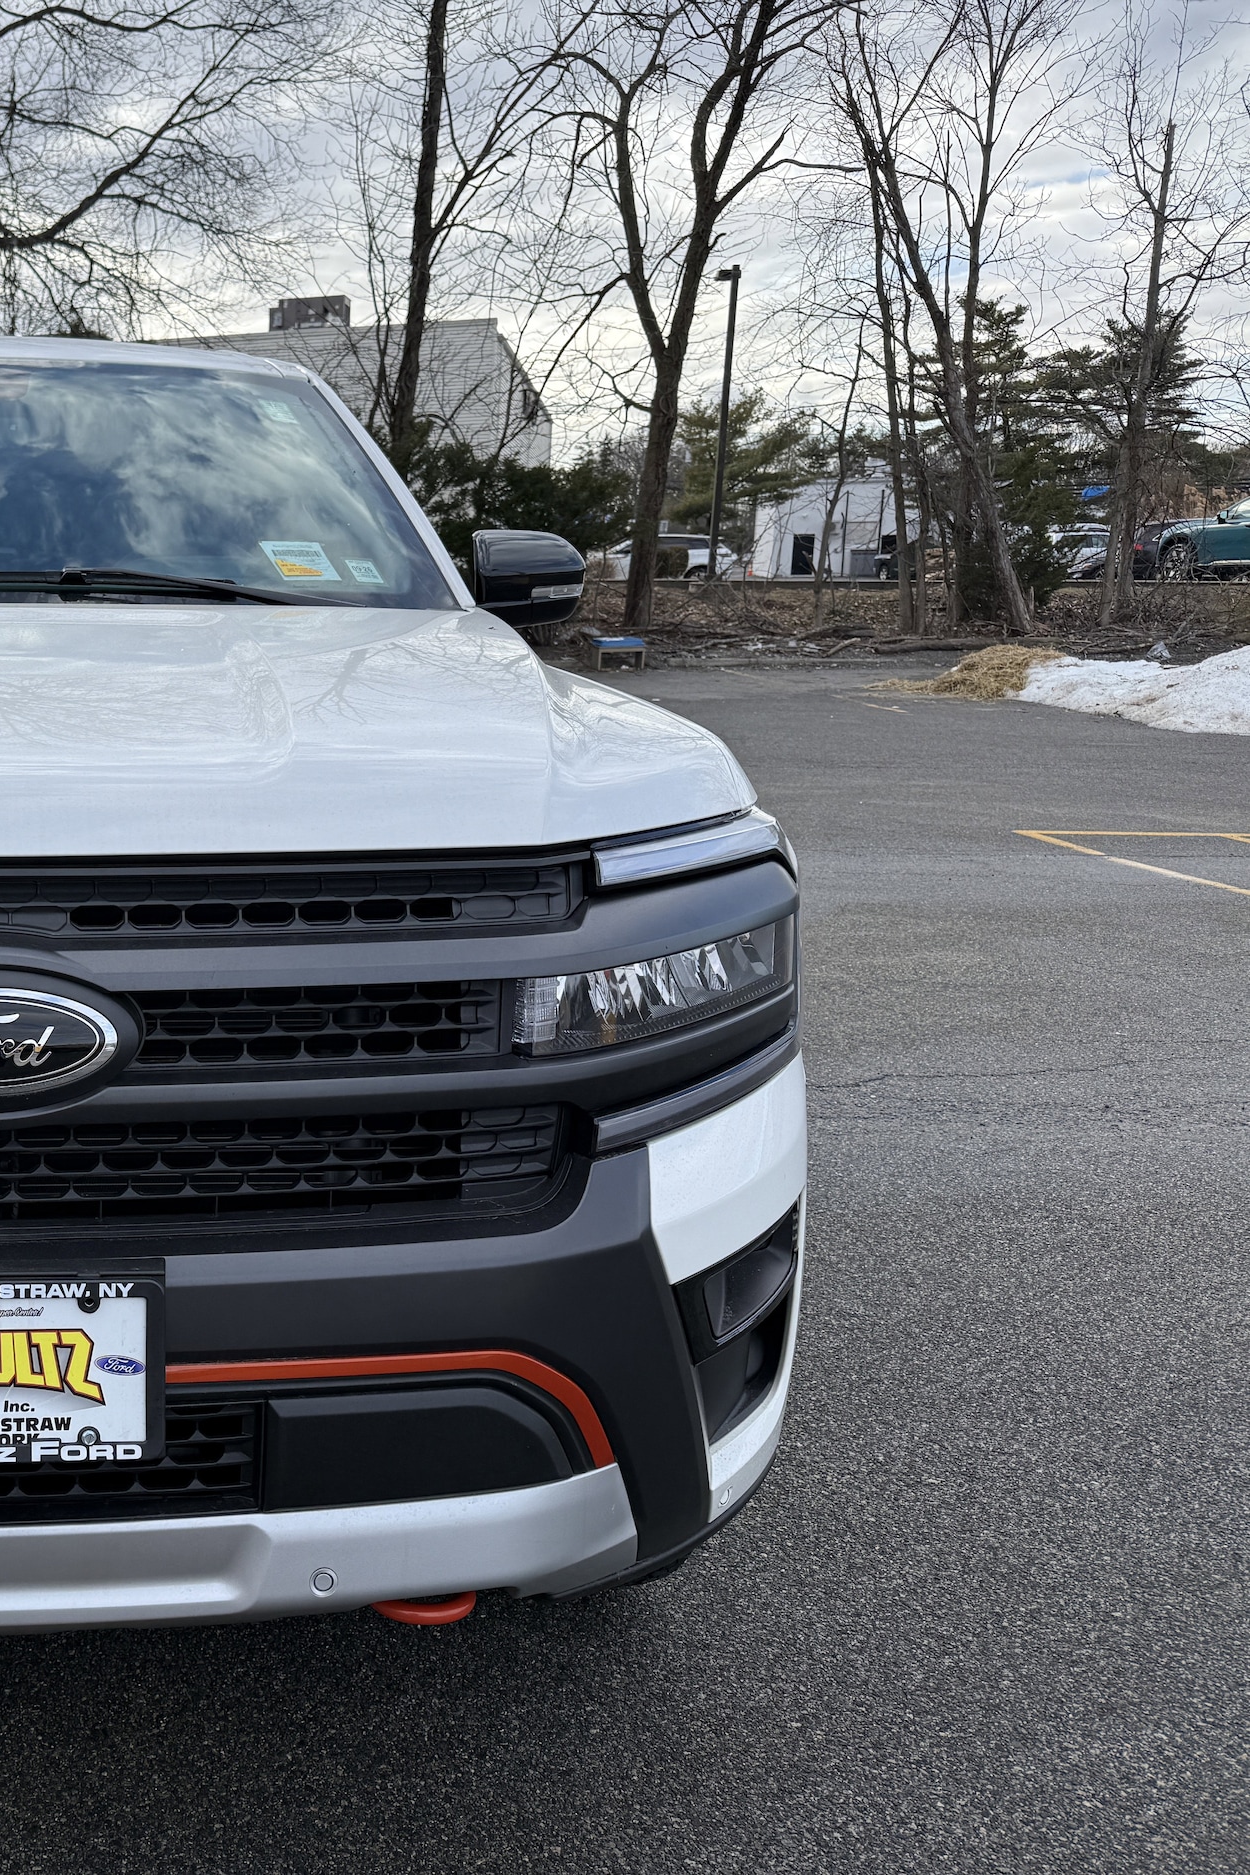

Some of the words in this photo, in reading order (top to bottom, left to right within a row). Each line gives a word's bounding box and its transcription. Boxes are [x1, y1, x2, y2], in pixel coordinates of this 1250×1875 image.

[98, 1283, 134, 1298] NY
[103, 1357, 136, 1373] Ford
[3, 1400, 36, 1413] Inc.
